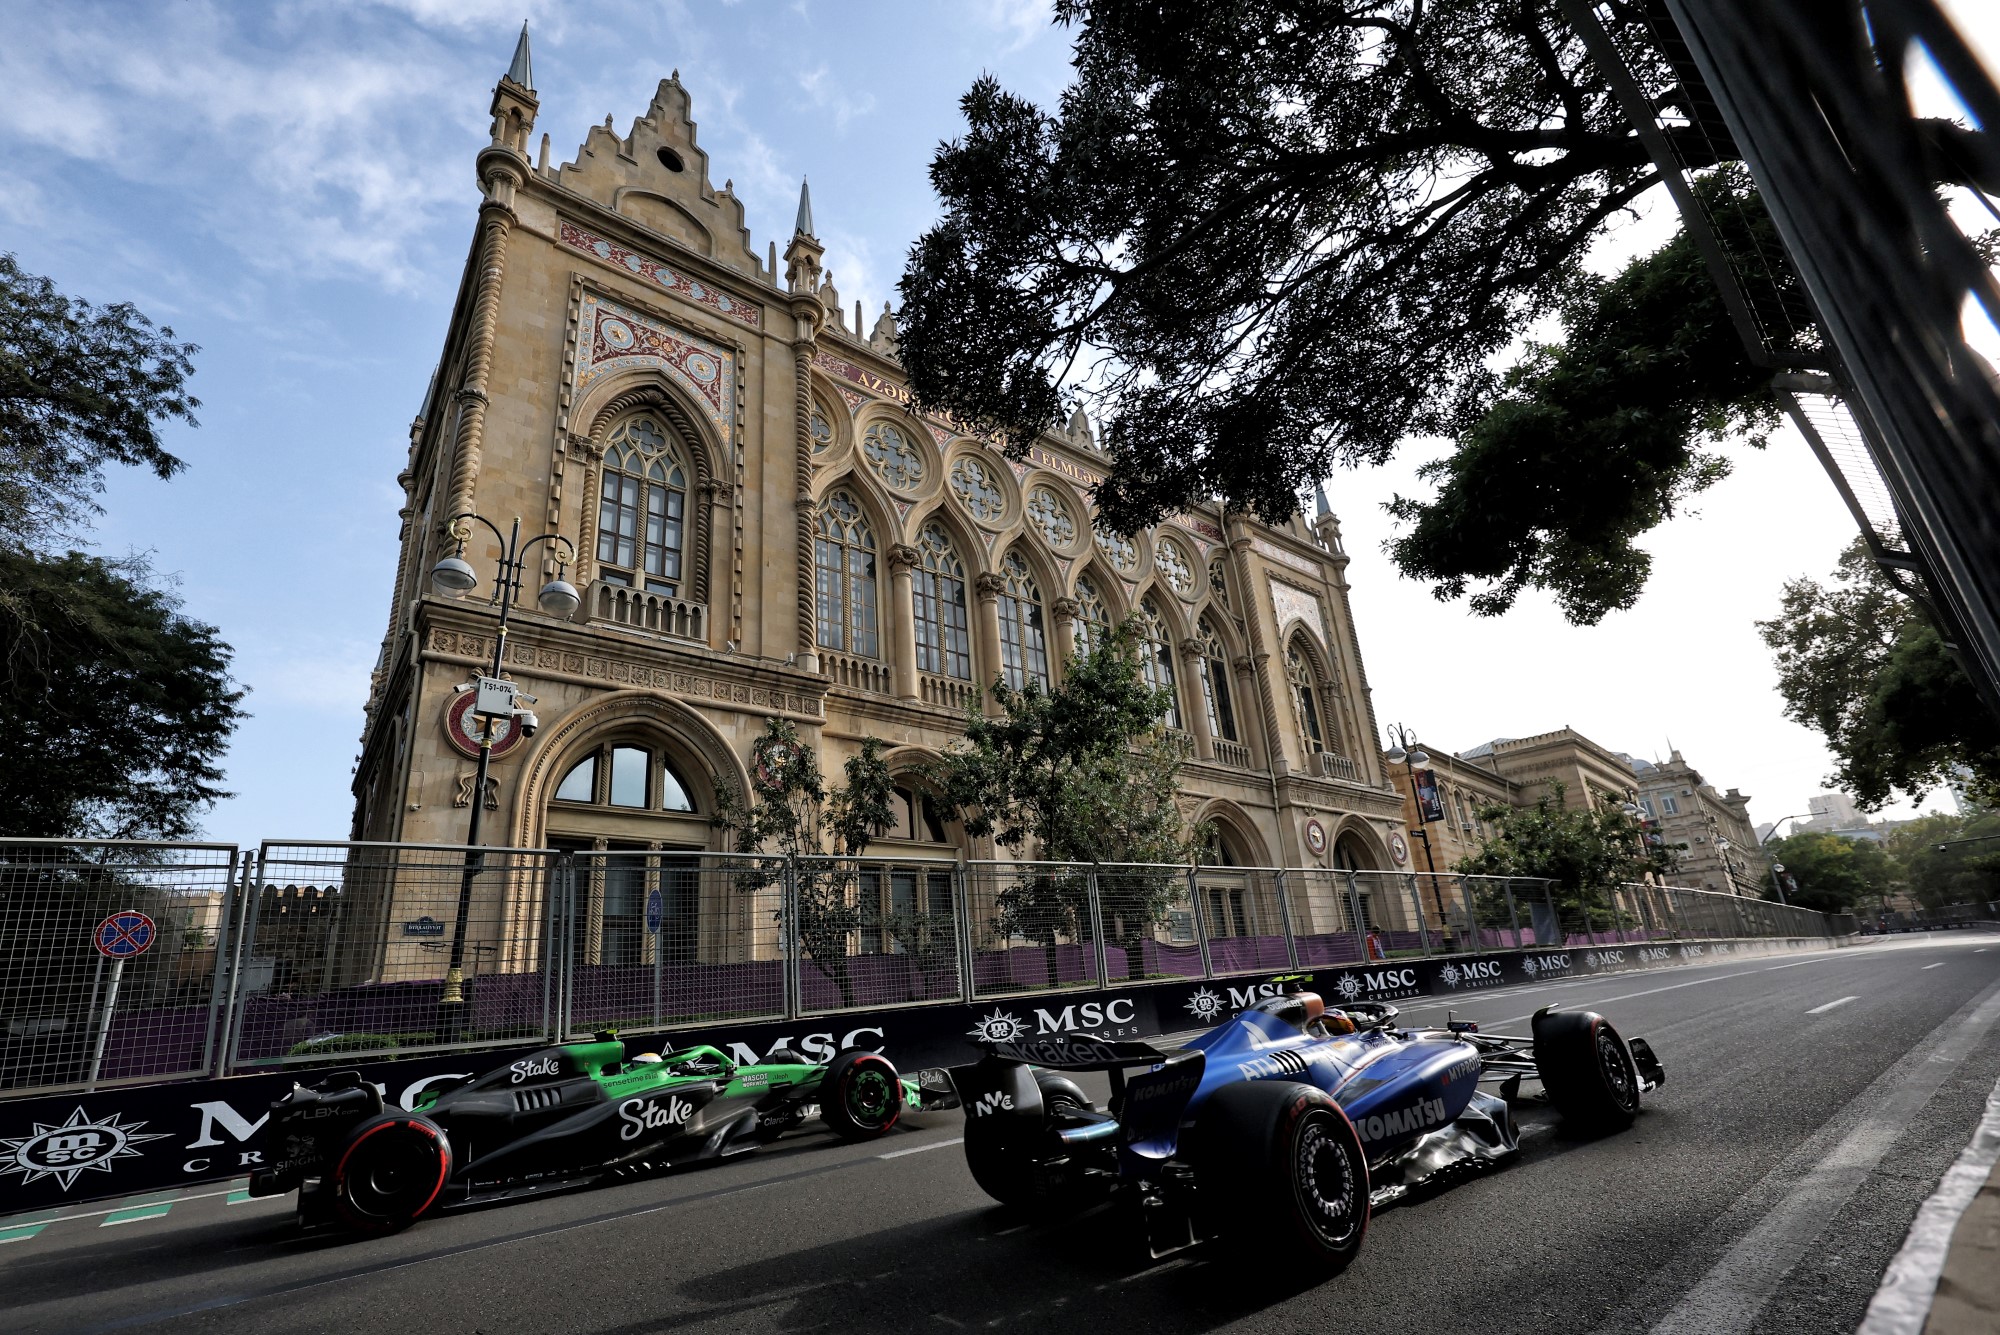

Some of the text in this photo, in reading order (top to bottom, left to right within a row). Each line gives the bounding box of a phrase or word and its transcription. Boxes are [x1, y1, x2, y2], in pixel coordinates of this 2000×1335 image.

[1538, 954, 1570, 971] MSC
[1598, 951, 1625, 965] MSC
[1461, 961, 1502, 980] MSC
[1363, 969, 1416, 992] MSC
[1466, 978, 1505, 988] CRUISES
[1368, 988, 1420, 1001] CRUISES
[1033, 999, 1136, 1035] MSC
[510, 1057, 560, 1084] Stake
[742, 1073, 768, 1082] MASCOT
[603, 1075, 644, 1089] sensetime
[742, 1080, 768, 1088] WORKWEAR
[920, 1071, 944, 1087] Stake
[618, 1095, 693, 1141] Stake
[763, 1112, 786, 1127] Claro
[1351, 1097, 1446, 1143] KOMATSU
